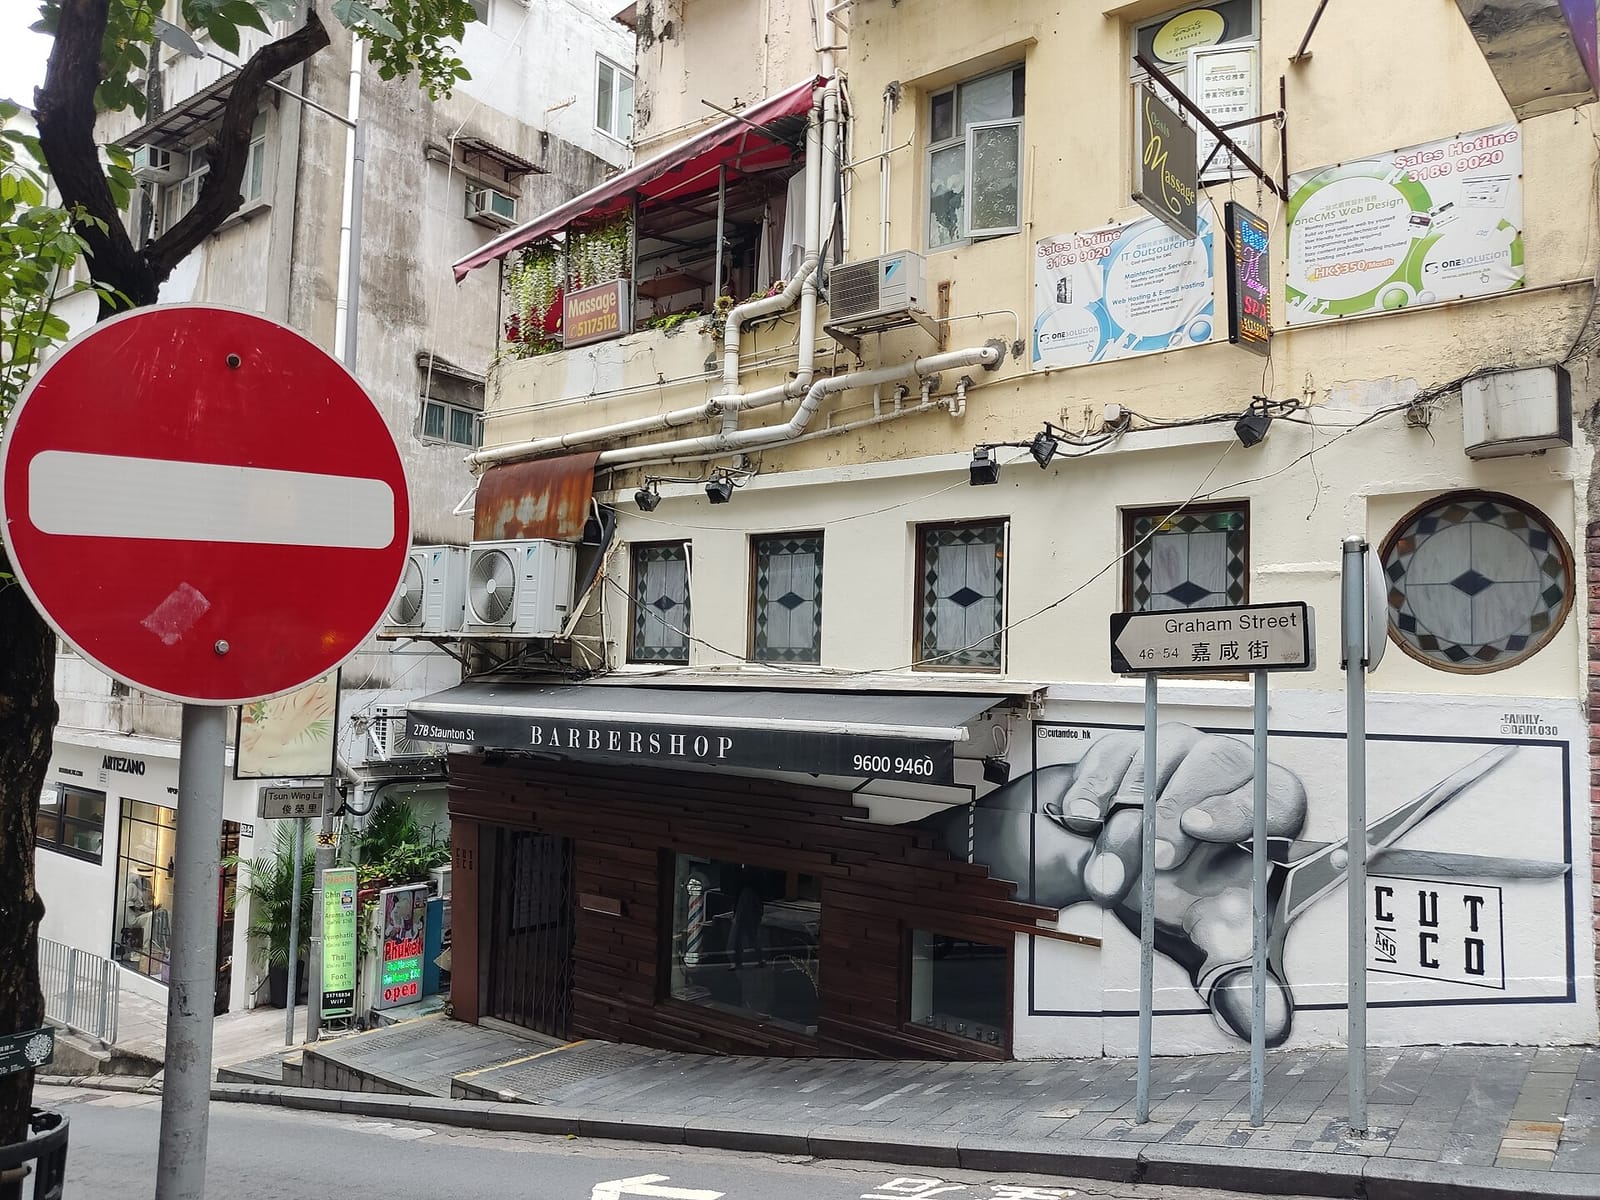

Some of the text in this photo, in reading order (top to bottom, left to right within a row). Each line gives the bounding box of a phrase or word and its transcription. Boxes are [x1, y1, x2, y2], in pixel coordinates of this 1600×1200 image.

[1395, 131, 1518, 169] Sales Hotline
[1408, 150, 1504, 183] 3189 9020
[1295, 198, 1404, 226] oneCMS Web Design
[1038, 242, 1071, 257] Sales
[1074, 231, 1121, 249] Hotline
[1121, 252, 1130, 261] IT
[1133, 240, 1195, 258] Outsourcing
[1047, 246, 1111, 269] 3189 9020
[1124, 259, 1192, 279] Maintenance Service
[1112, 297, 1126, 305] Web
[1128, 292, 1151, 302] Hosting
[1159, 286, 1179, 295] E-mail
[1181, 281, 1205, 291] Hosting
[568, 292, 616, 318] Massage
[577, 313, 617, 336] 51175112
[1165, 612, 1297, 633] Graham Street
[1191, 640, 1269, 662] 嘉咸街
[413, 723, 475, 741] 27B Staunton St
[530, 725, 733, 759] BARBERSHOP
[1047, 728, 1091, 740] cutandco_hk
[102, 754, 145, 776] ARTEZANO
[853, 754, 933, 776] 9600 9460
[268, 792, 288, 800] Tsun
[291, 792, 310, 801] Wing
[282, 804, 317, 814] 俊榮里
[1374, 885, 1485, 932] CUT
[385, 940, 423, 961] Phuket
[1375, 933, 1396, 956] AND
[1418, 932, 1485, 976] CO
[384, 982, 417, 1002] open
